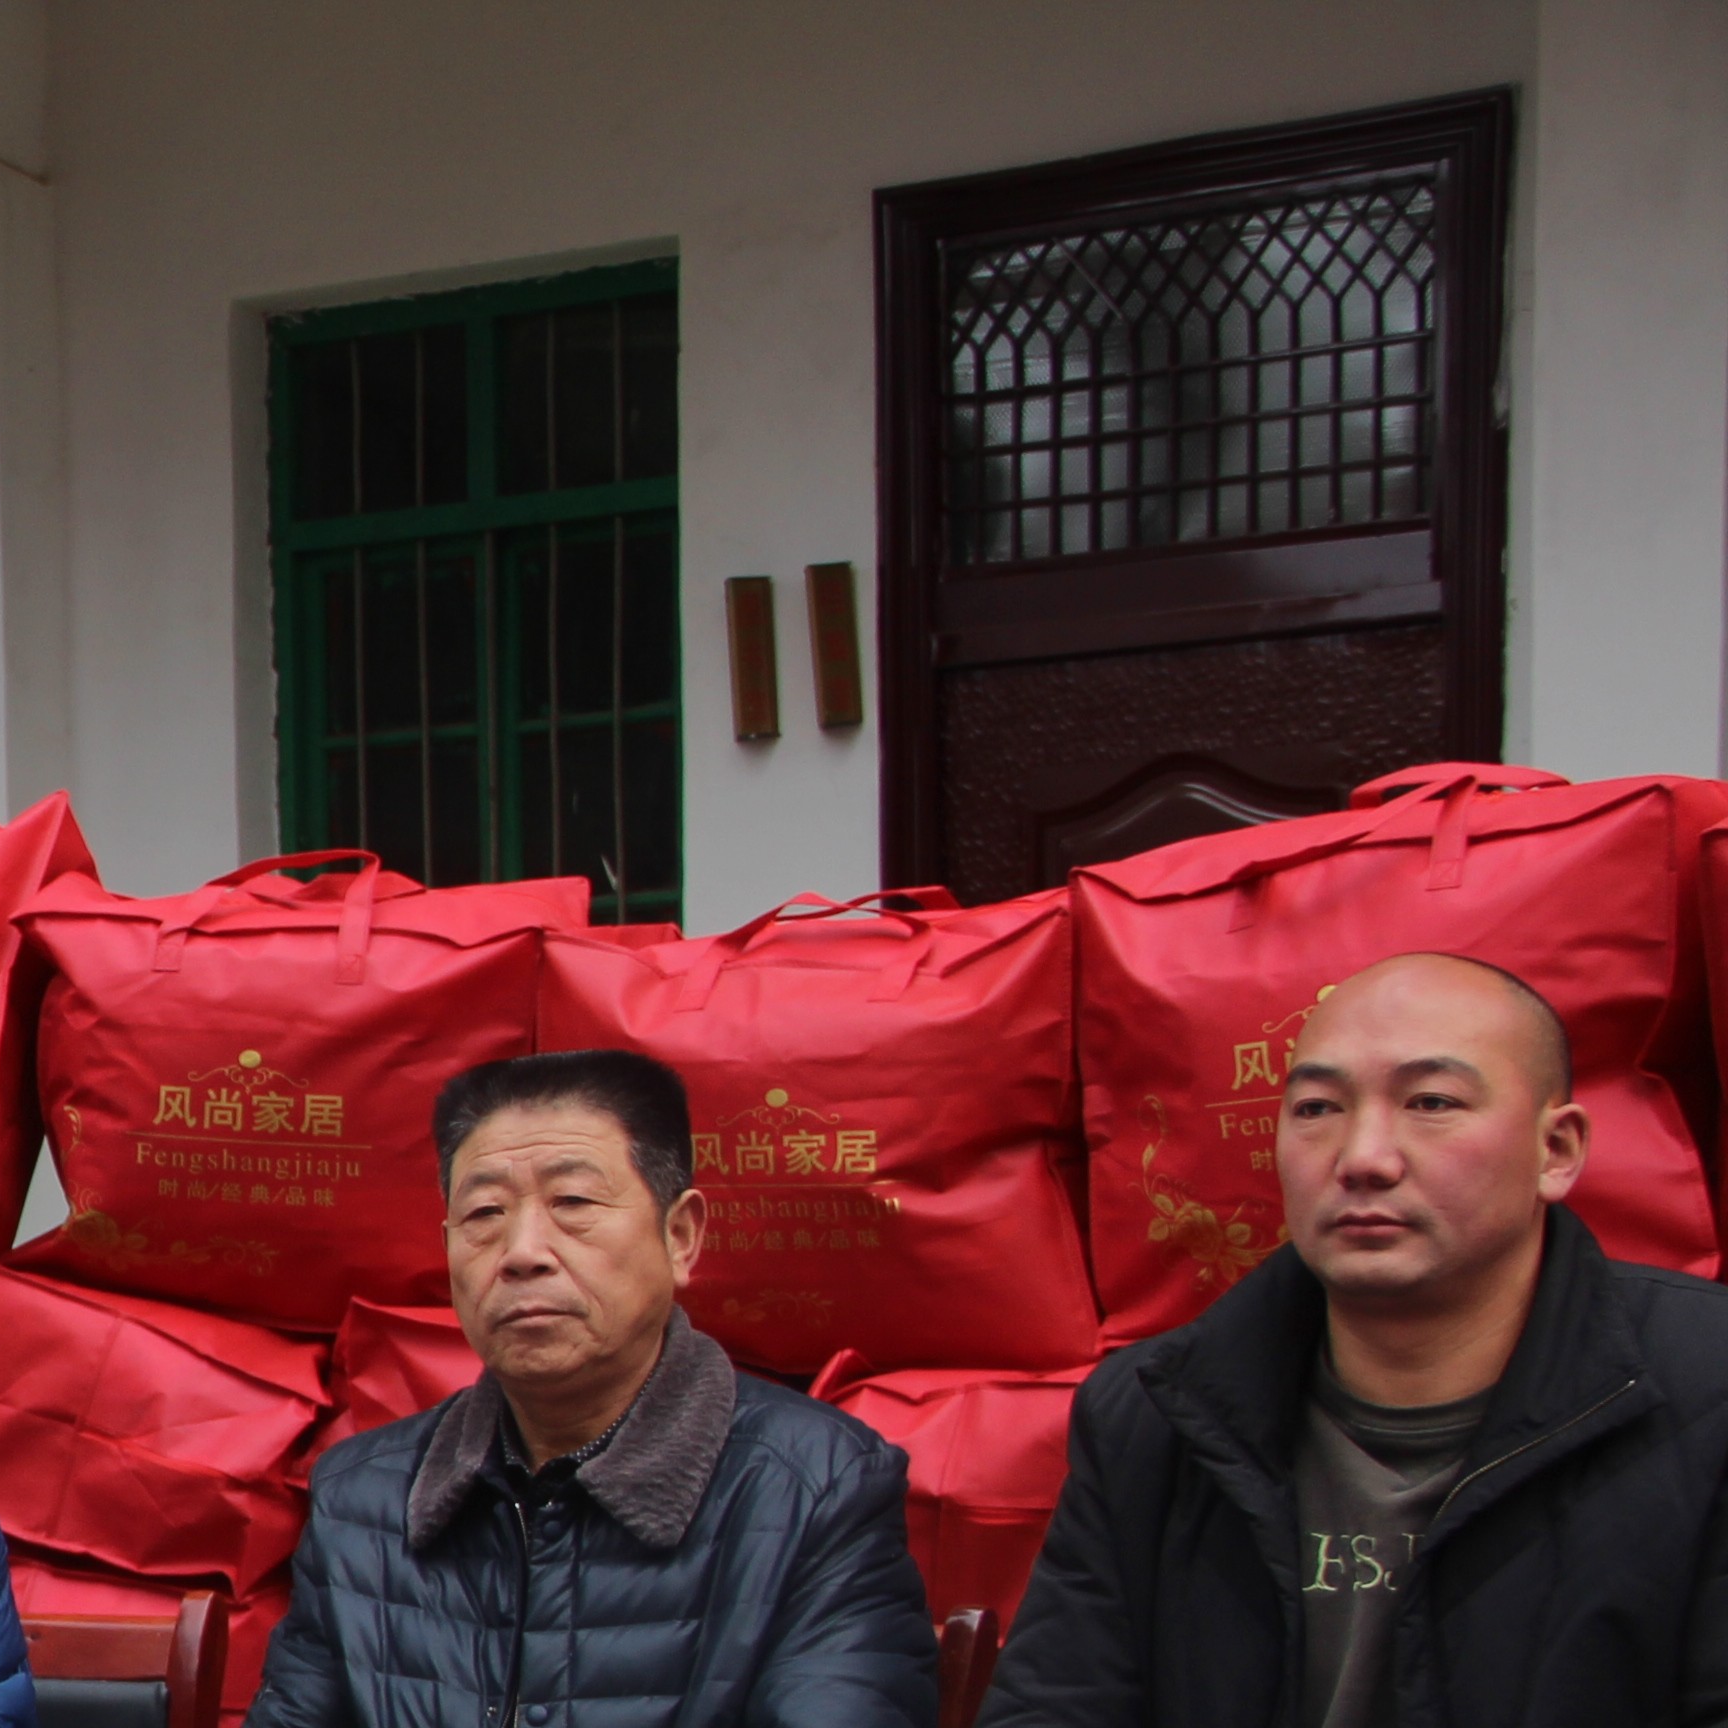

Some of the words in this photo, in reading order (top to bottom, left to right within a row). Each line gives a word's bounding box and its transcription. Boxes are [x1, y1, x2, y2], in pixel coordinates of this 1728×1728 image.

[153, 1085, 344, 1137] 风尚家居
[136, 1142, 362, 1181] Fengshangjiaju
[691, 1129, 879, 1175] 风尚家居
[710, 1193, 901, 1223] ngshangjiaju
